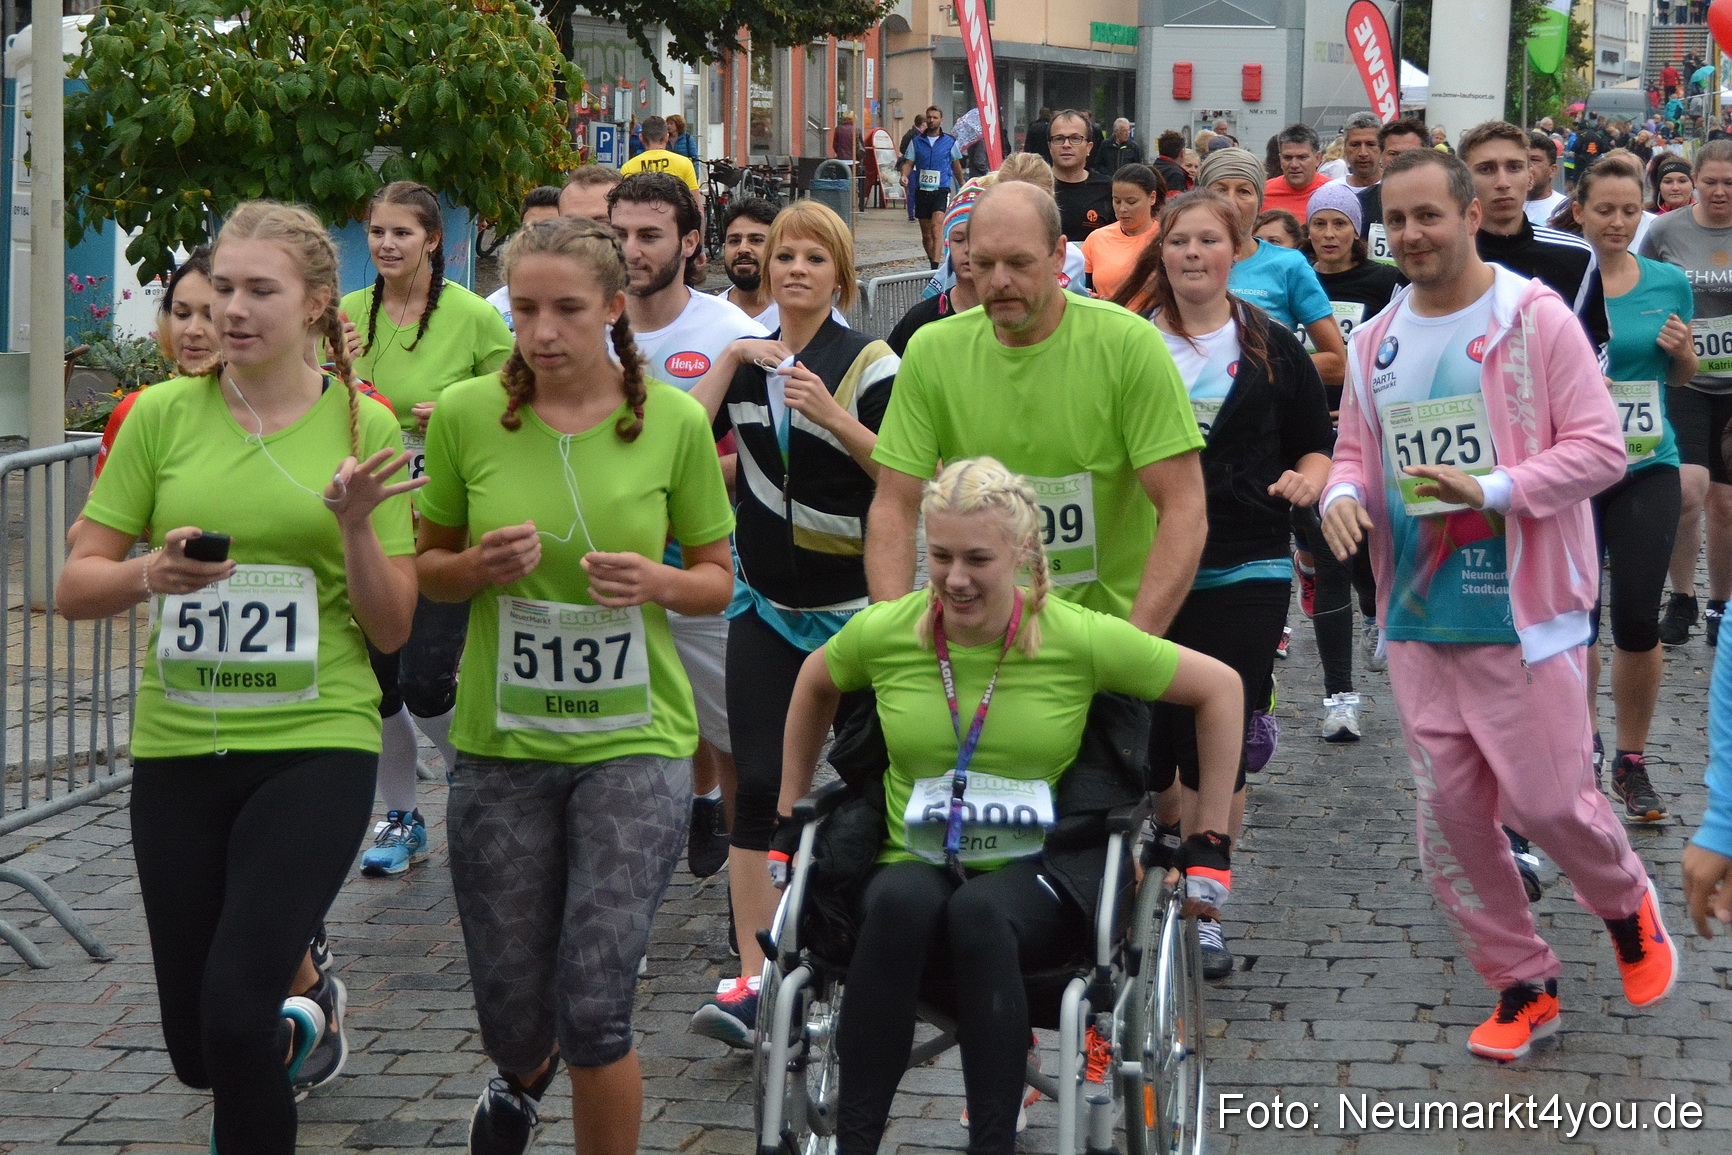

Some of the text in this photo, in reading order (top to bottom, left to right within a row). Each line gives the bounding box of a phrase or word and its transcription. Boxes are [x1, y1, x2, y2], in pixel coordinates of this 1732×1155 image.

[600, 131, 611, 148] P
[641, 158, 669, 173] MTP
[921, 175, 937, 183] 2281
[14, 205, 30, 216] 09184
[1235, 288, 1268, 297] PFLEIDERER
[671, 357, 705, 371] Hervis
[1417, 398, 1475, 419] BOCK
[1395, 422, 1481, 472] 5125
[1461, 548, 1492, 567] 17.
[229, 570, 304, 589] BOCK
[560, 608, 631, 625] BOCK
[177, 601, 297, 652] 5121
[513, 631, 632, 684] 5137
[196, 667, 277, 688] Theresa
[545, 695, 600, 713] Elena
[969, 775, 1036, 795] BOCK
